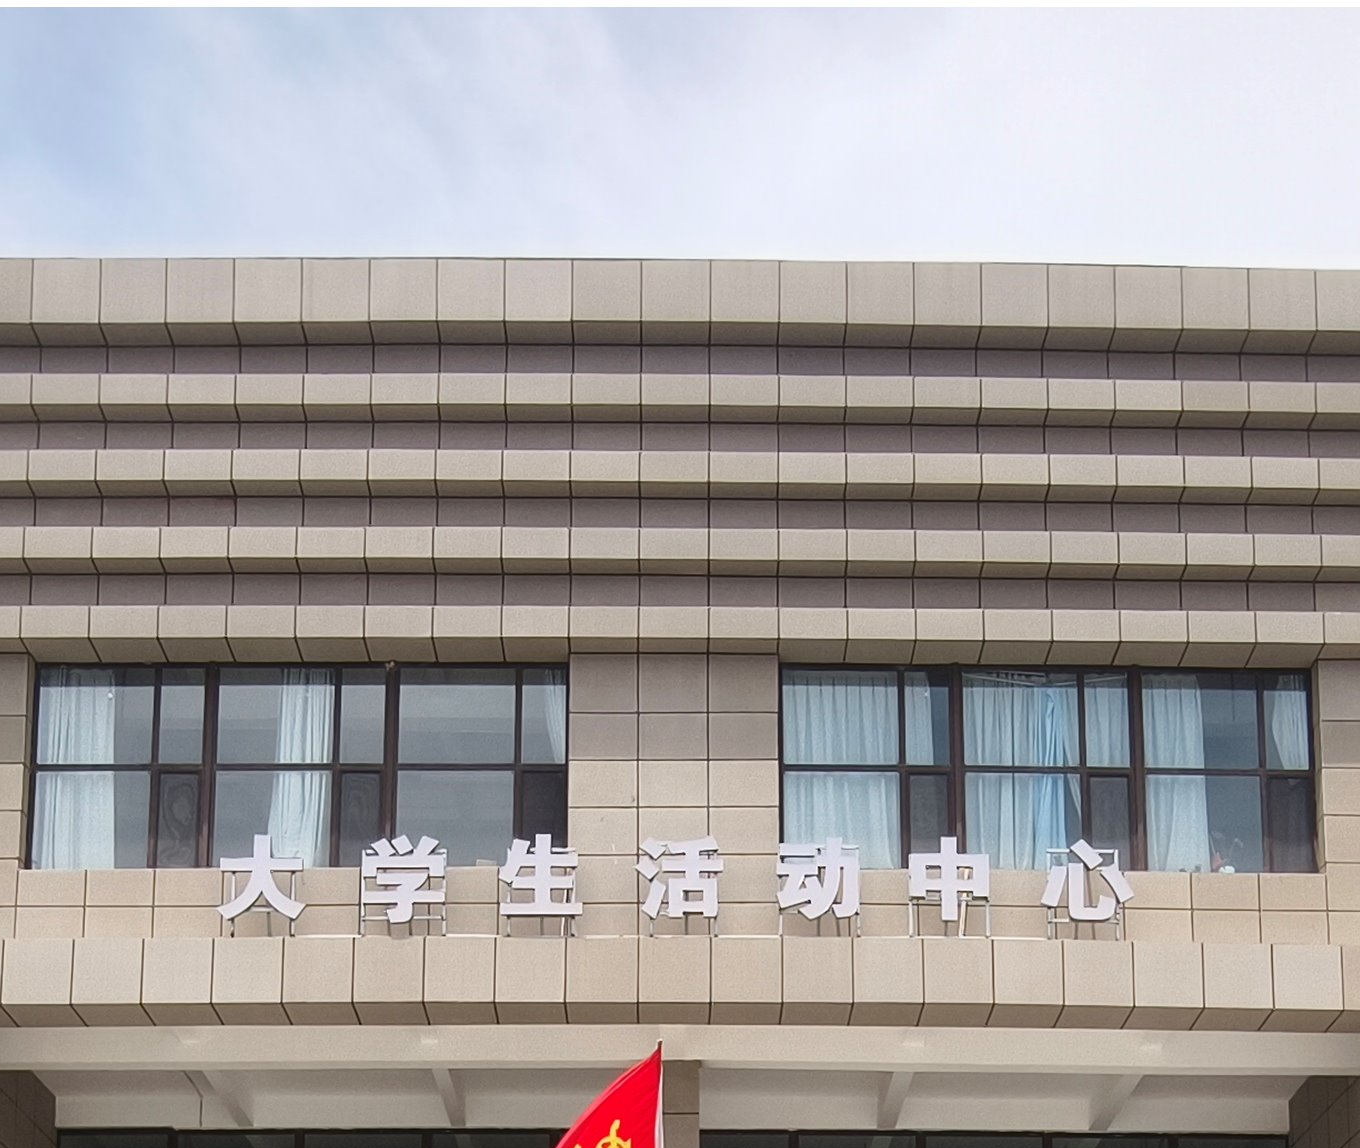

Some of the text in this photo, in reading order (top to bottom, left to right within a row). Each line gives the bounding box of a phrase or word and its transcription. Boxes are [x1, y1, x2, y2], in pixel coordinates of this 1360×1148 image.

[217, 833, 1135, 924] 大学生活动中心
